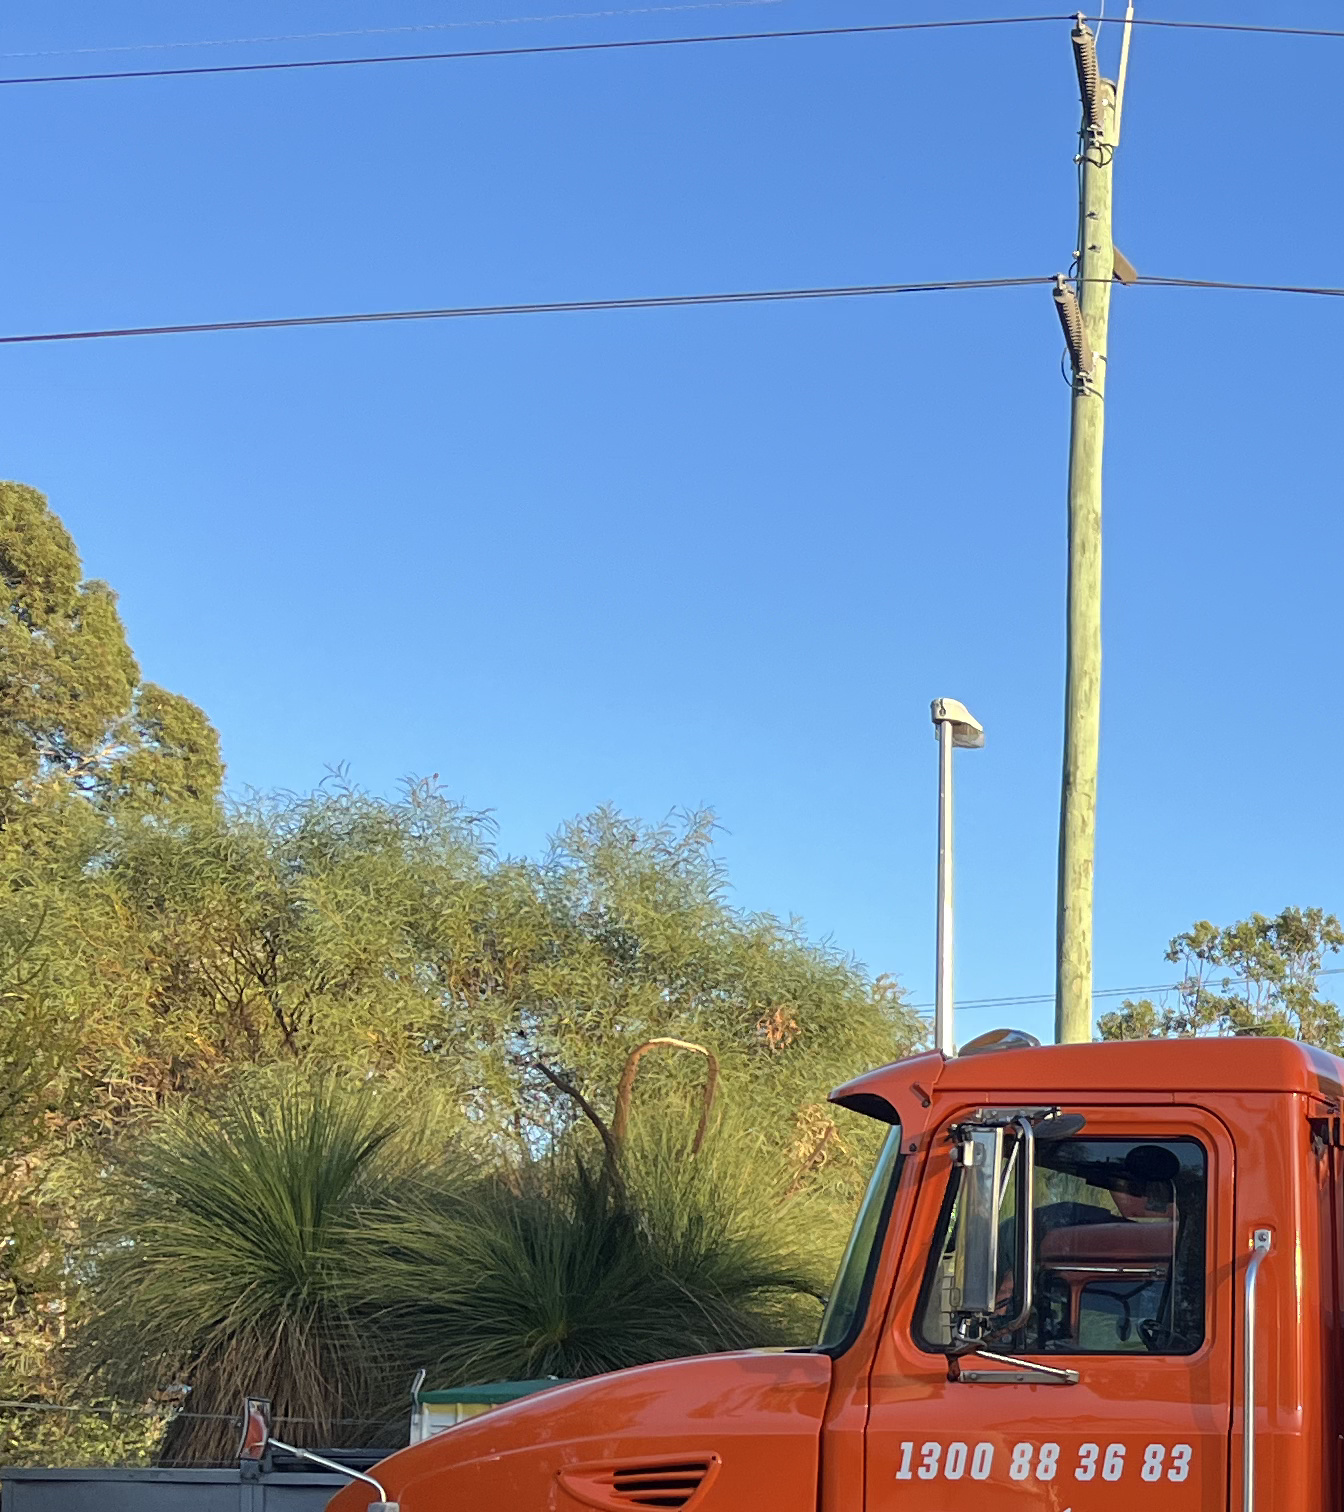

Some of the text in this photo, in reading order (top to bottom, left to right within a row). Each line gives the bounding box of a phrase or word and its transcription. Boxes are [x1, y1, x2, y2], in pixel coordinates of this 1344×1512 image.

[895, 1441, 1193, 1483] 1300 88 36 83
